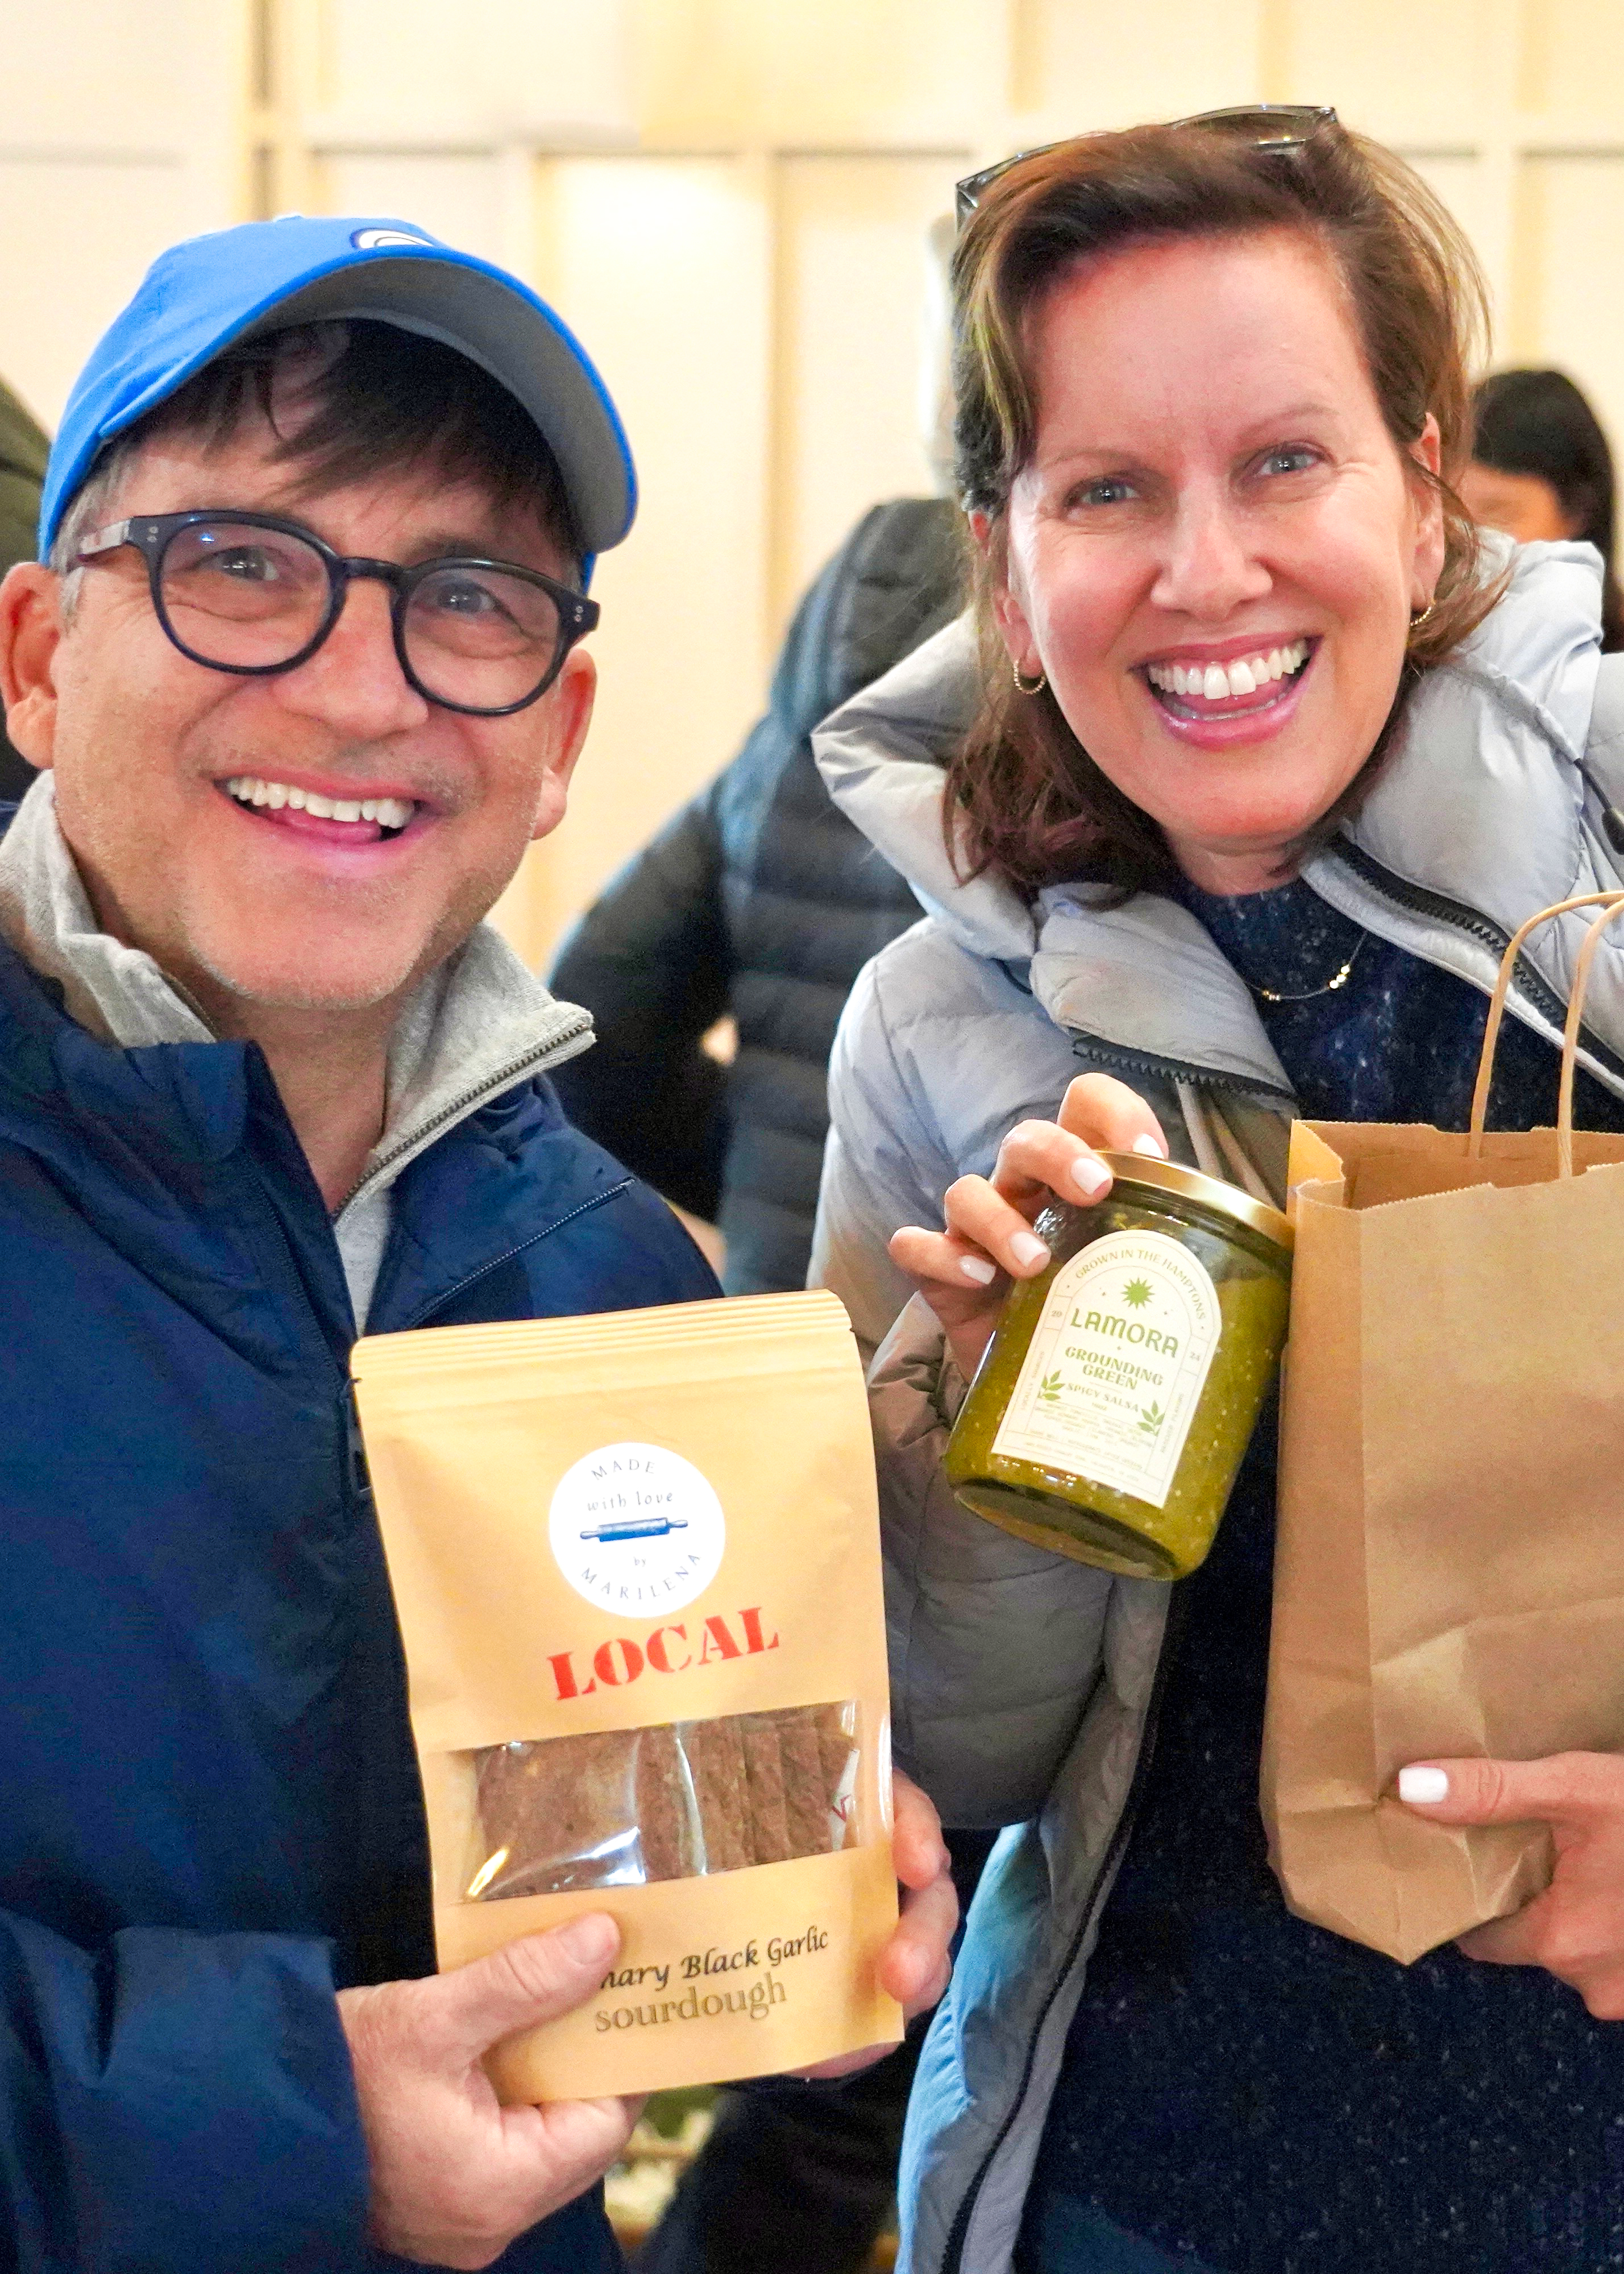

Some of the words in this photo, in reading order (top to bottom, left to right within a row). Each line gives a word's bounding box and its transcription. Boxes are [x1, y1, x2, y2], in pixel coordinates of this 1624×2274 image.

[1075, 1250, 1118, 1278] GROWN
[1121, 1249, 1134, 1258] IN
[1137, 1250, 1162, 1264] THE
[1162, 1258, 1206, 1320] HAMPTONS
[1070, 1308, 1178, 1358] LAMORA
[1065, 1346, 1164, 1386] GROUNDING
[1082, 1363, 1137, 1391] GREEN
[1065, 1381, 1100, 1400] SPICY
[1103, 1392, 1139, 1413] SALSA
[591, 1458, 655, 1480] MADE
[587, 1493, 626, 1512] with
[636, 1491, 674, 1505] love
[580, 1553, 701, 1600] MARILENA
[634, 1557, 646, 1567] by
[547, 1606, 780, 1700] LOCAL
[679, 1938, 759, 1980] Black
[767, 1924, 829, 1967] Garlic
[595, 1971, 787, 2033] sourdough
